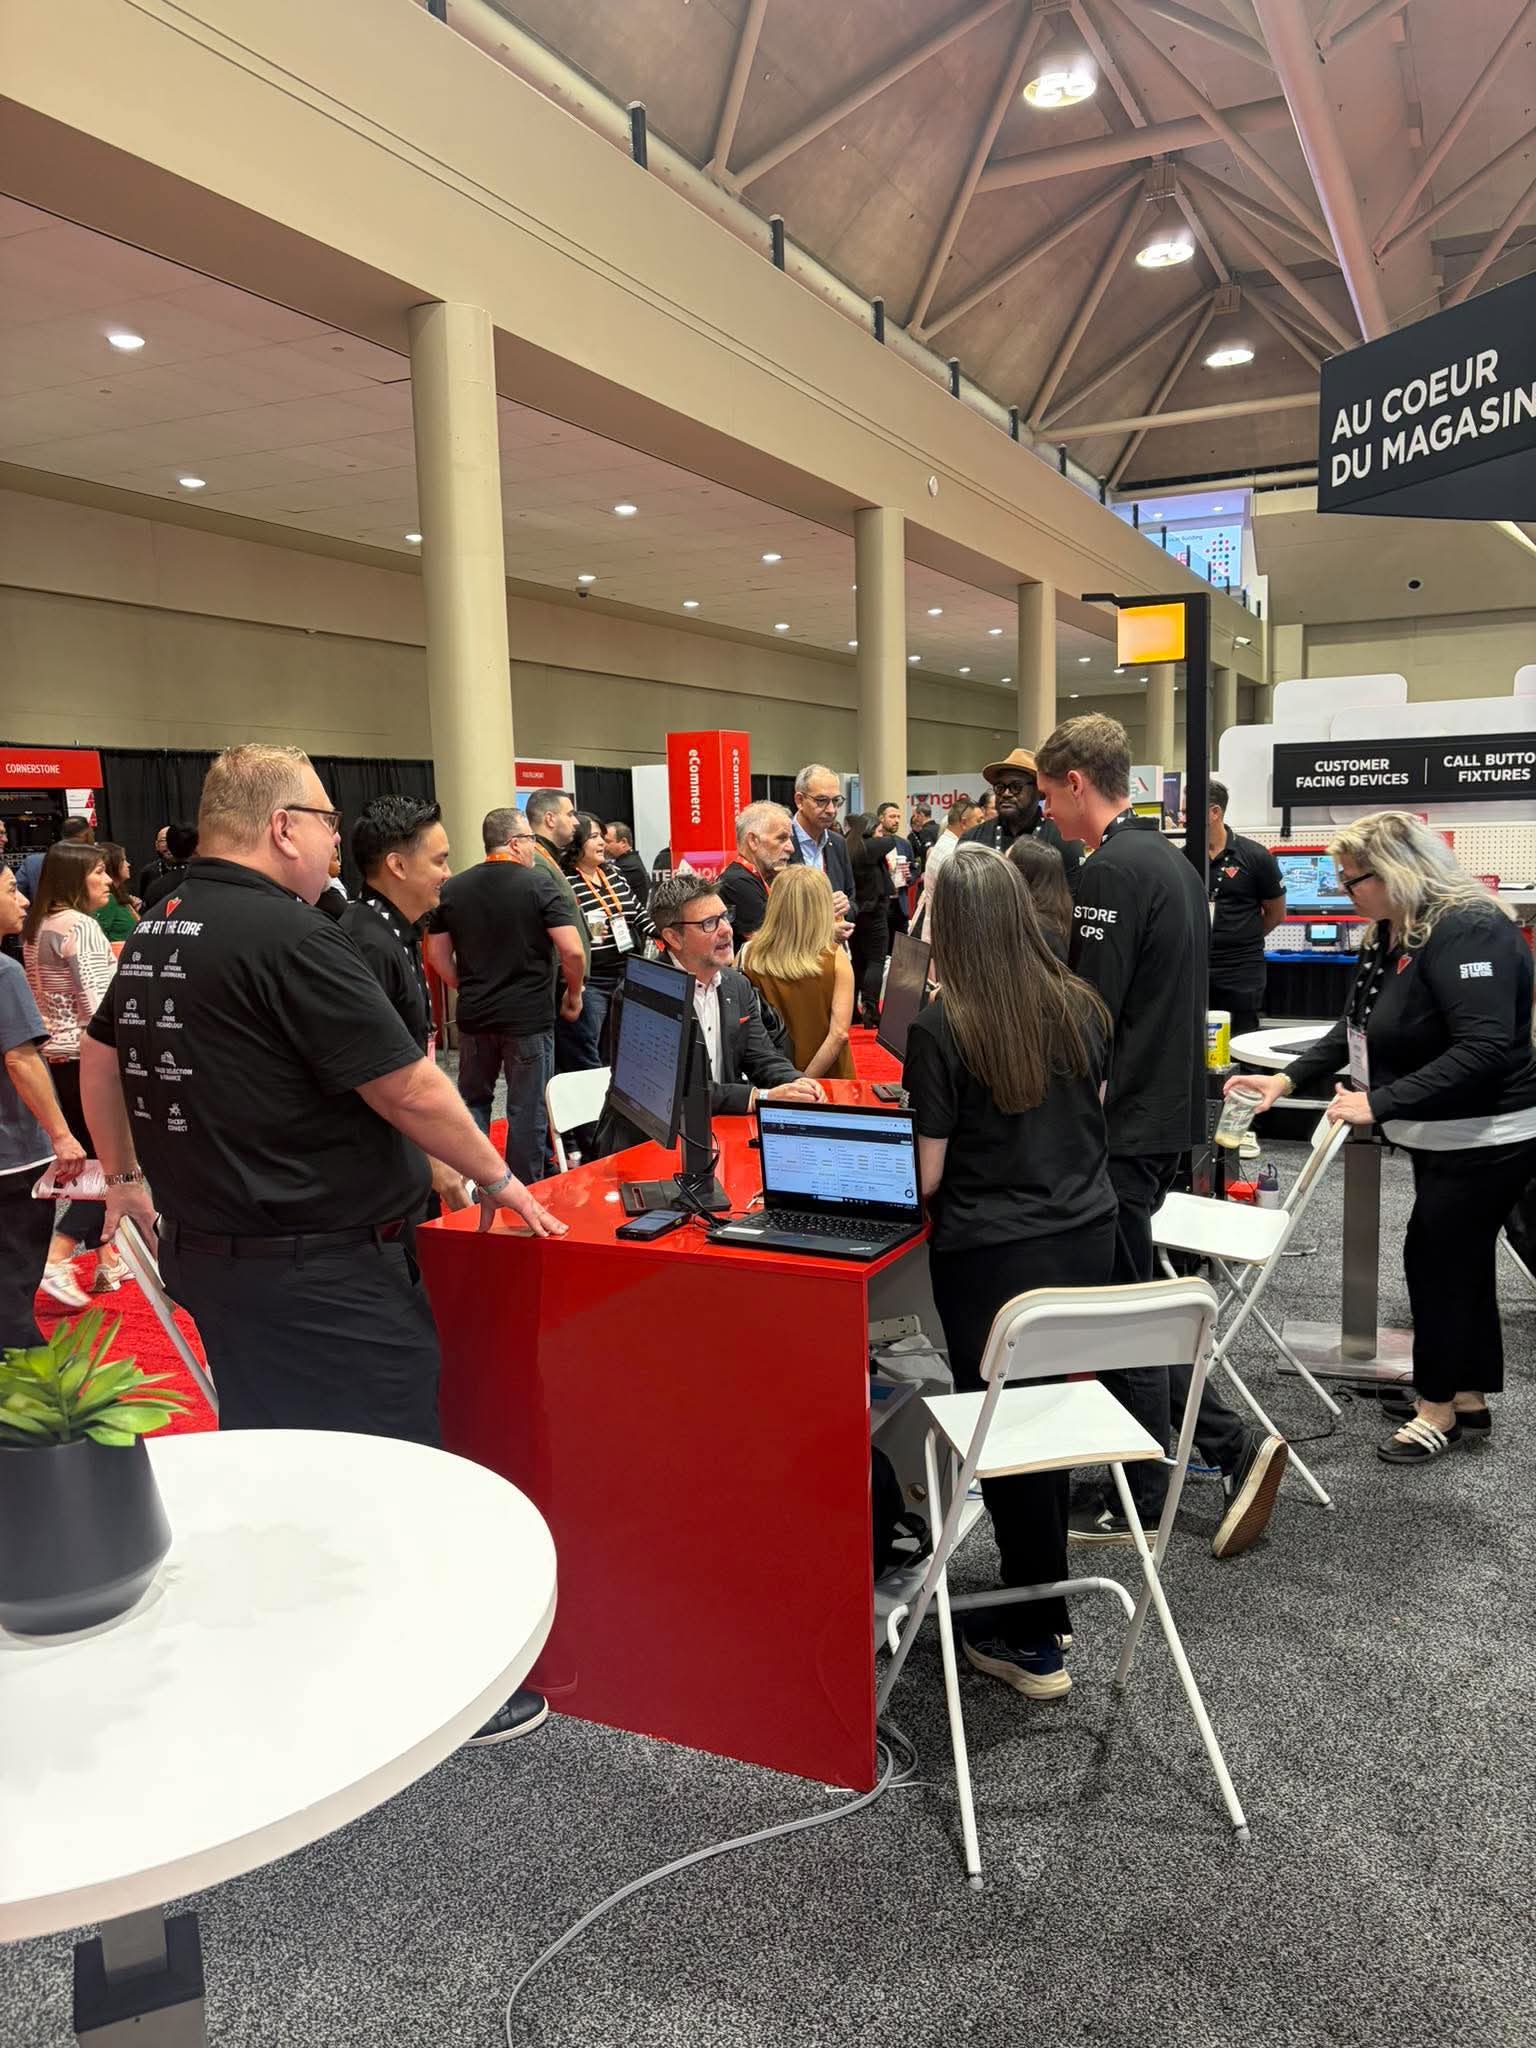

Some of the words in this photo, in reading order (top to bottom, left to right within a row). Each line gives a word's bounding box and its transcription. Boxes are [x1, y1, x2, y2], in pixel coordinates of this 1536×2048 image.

[1331, 399, 1372, 444] AU
[1381, 349, 1498, 423] COEUR
[1331, 444, 1372, 487] DU
[1382, 381, 1536, 471] MAGASIN
[5, 763, 60, 774] CORNERSTONE
[1314, 758, 1390, 773] CUSTOMER
[1443, 754, 1481, 768] CALL
[1295, 776, 1345, 788] FACING
[1349, 773, 1409, 787] DEVICES
[1458, 768, 1531, 783] FIXTURES
[688, 748, 701, 825] eCommerce
[1073, 905, 1118, 923] STORE
[152, 920, 166, 935] AT
[177, 920, 204, 937] CORE
[1459, 961, 1493, 973] STORE
